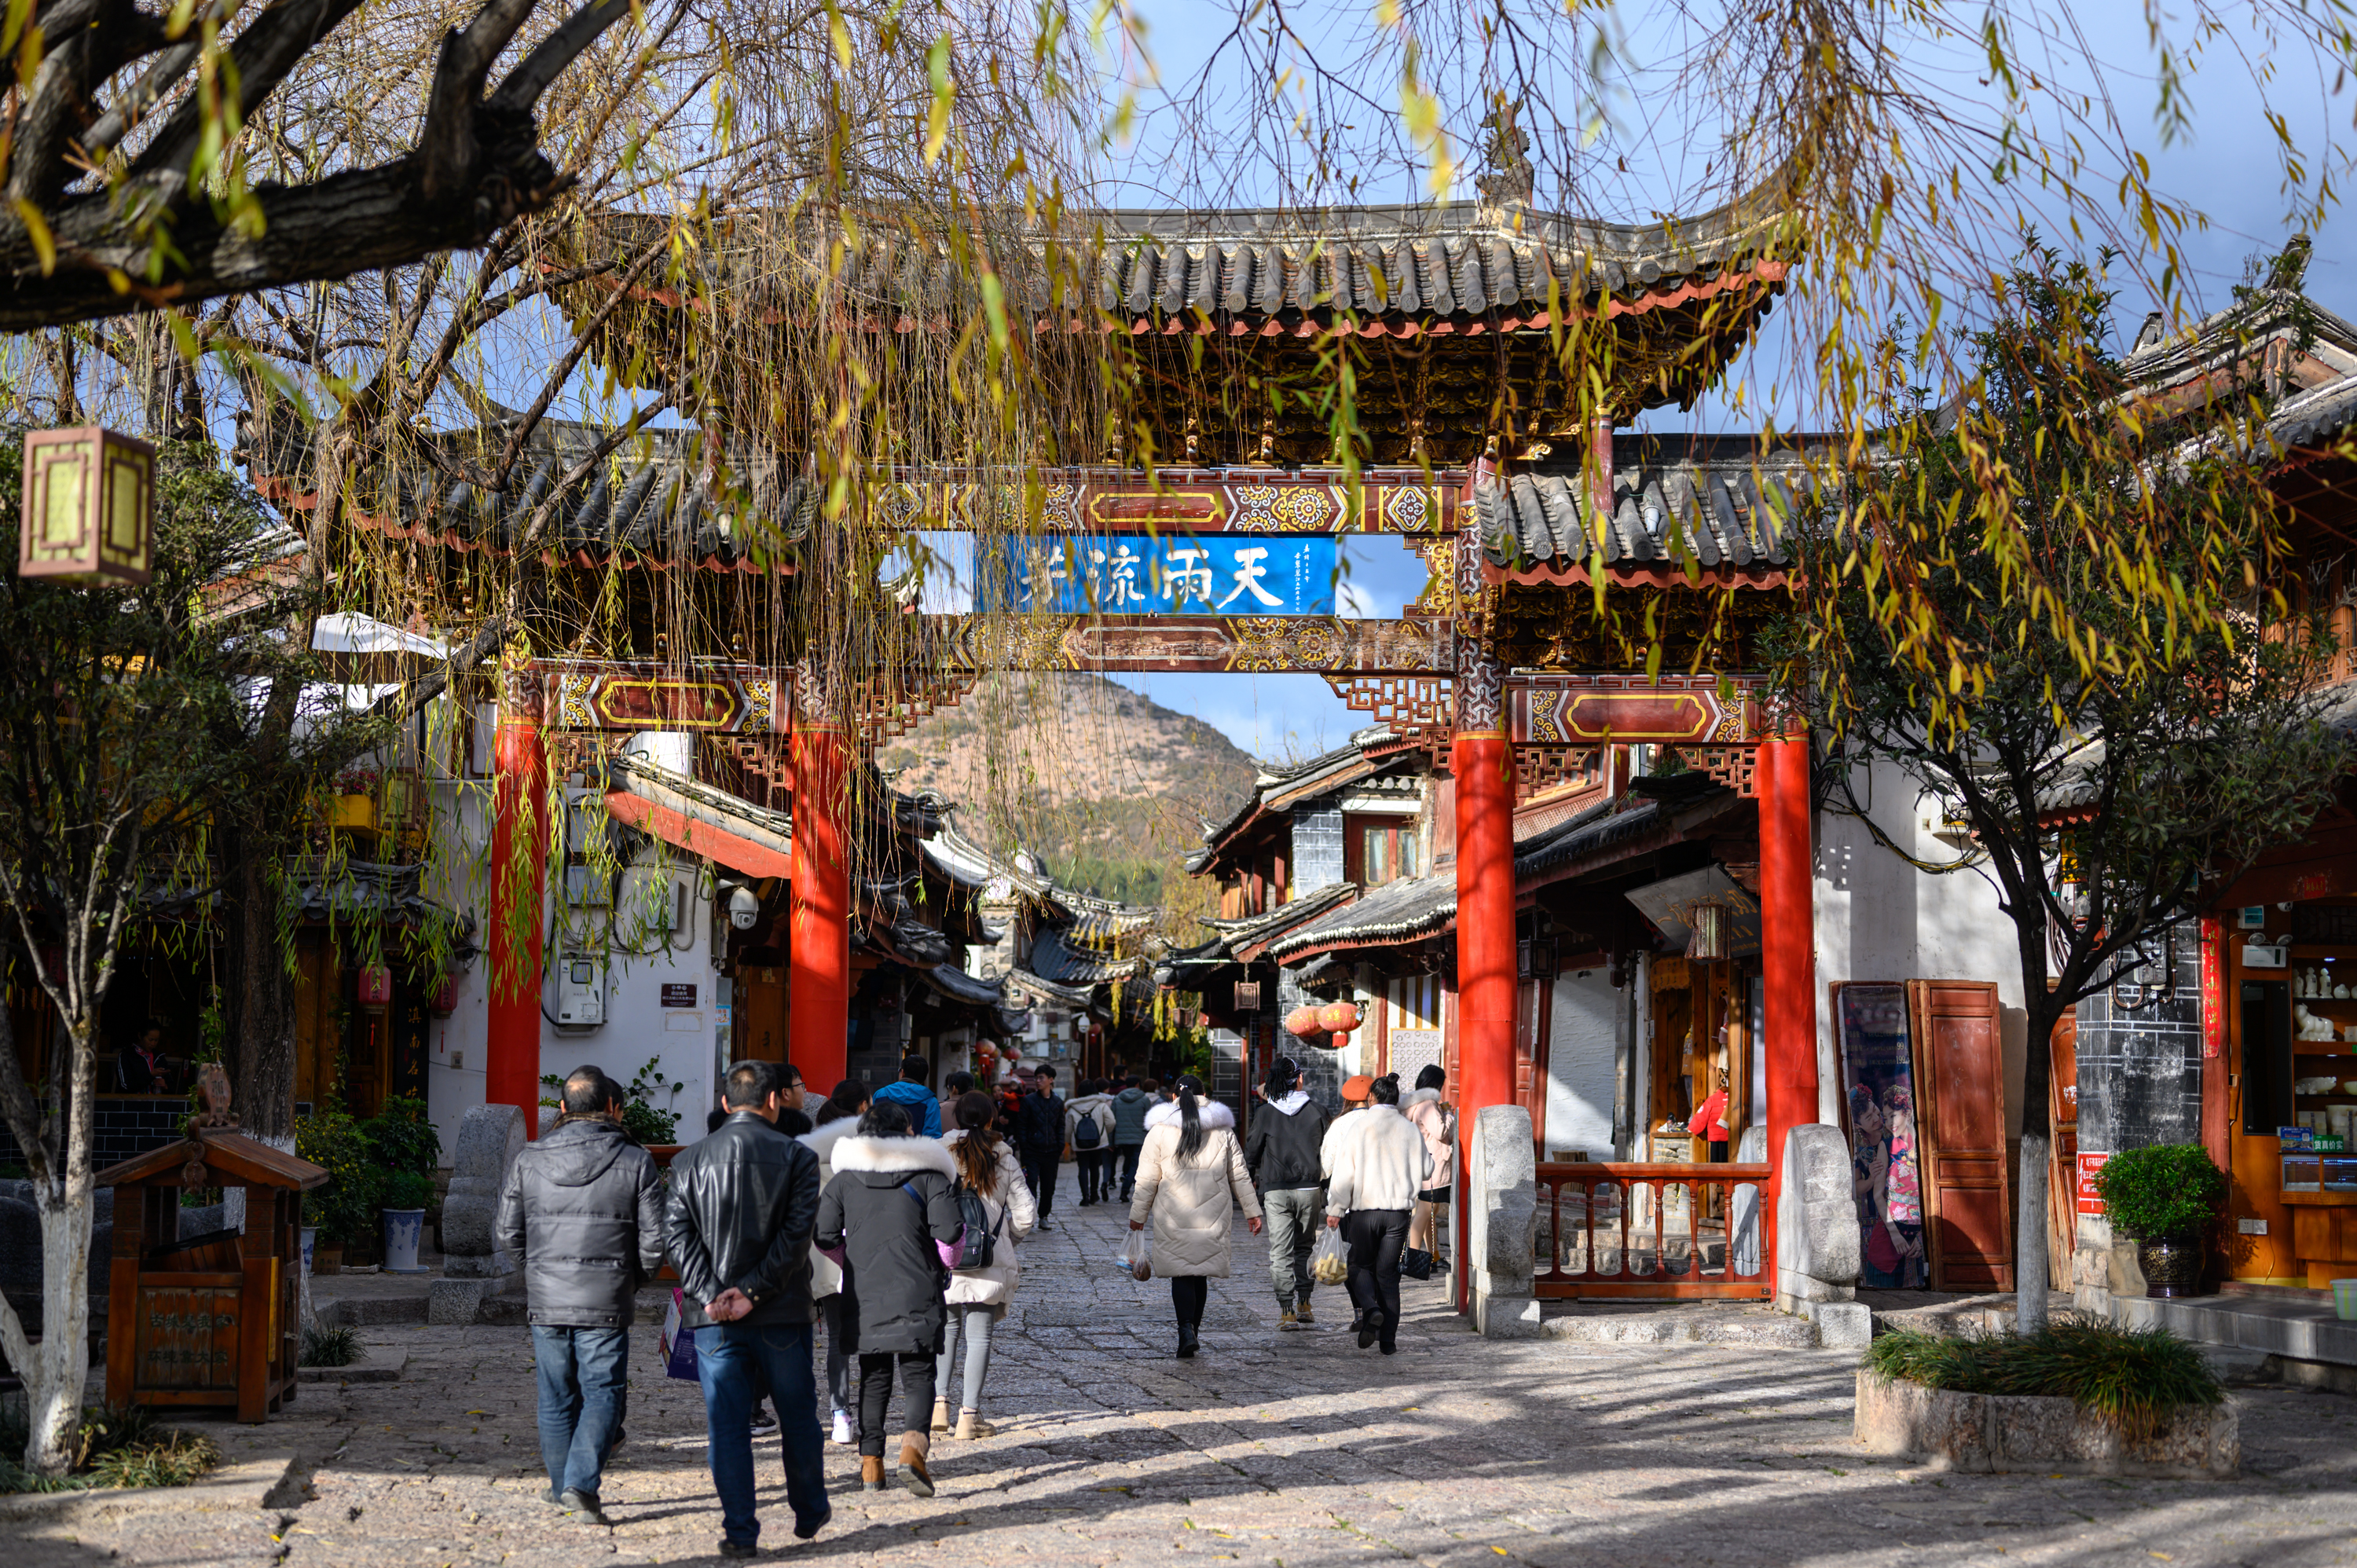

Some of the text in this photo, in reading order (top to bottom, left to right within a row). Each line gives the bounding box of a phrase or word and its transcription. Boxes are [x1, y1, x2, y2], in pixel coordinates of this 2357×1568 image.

[2314, 1140, 2343, 1150] 货真价实
[149, 1313, 229, 1329] 古城是我家
[147, 1350, 228, 1365] 环境靠大家
